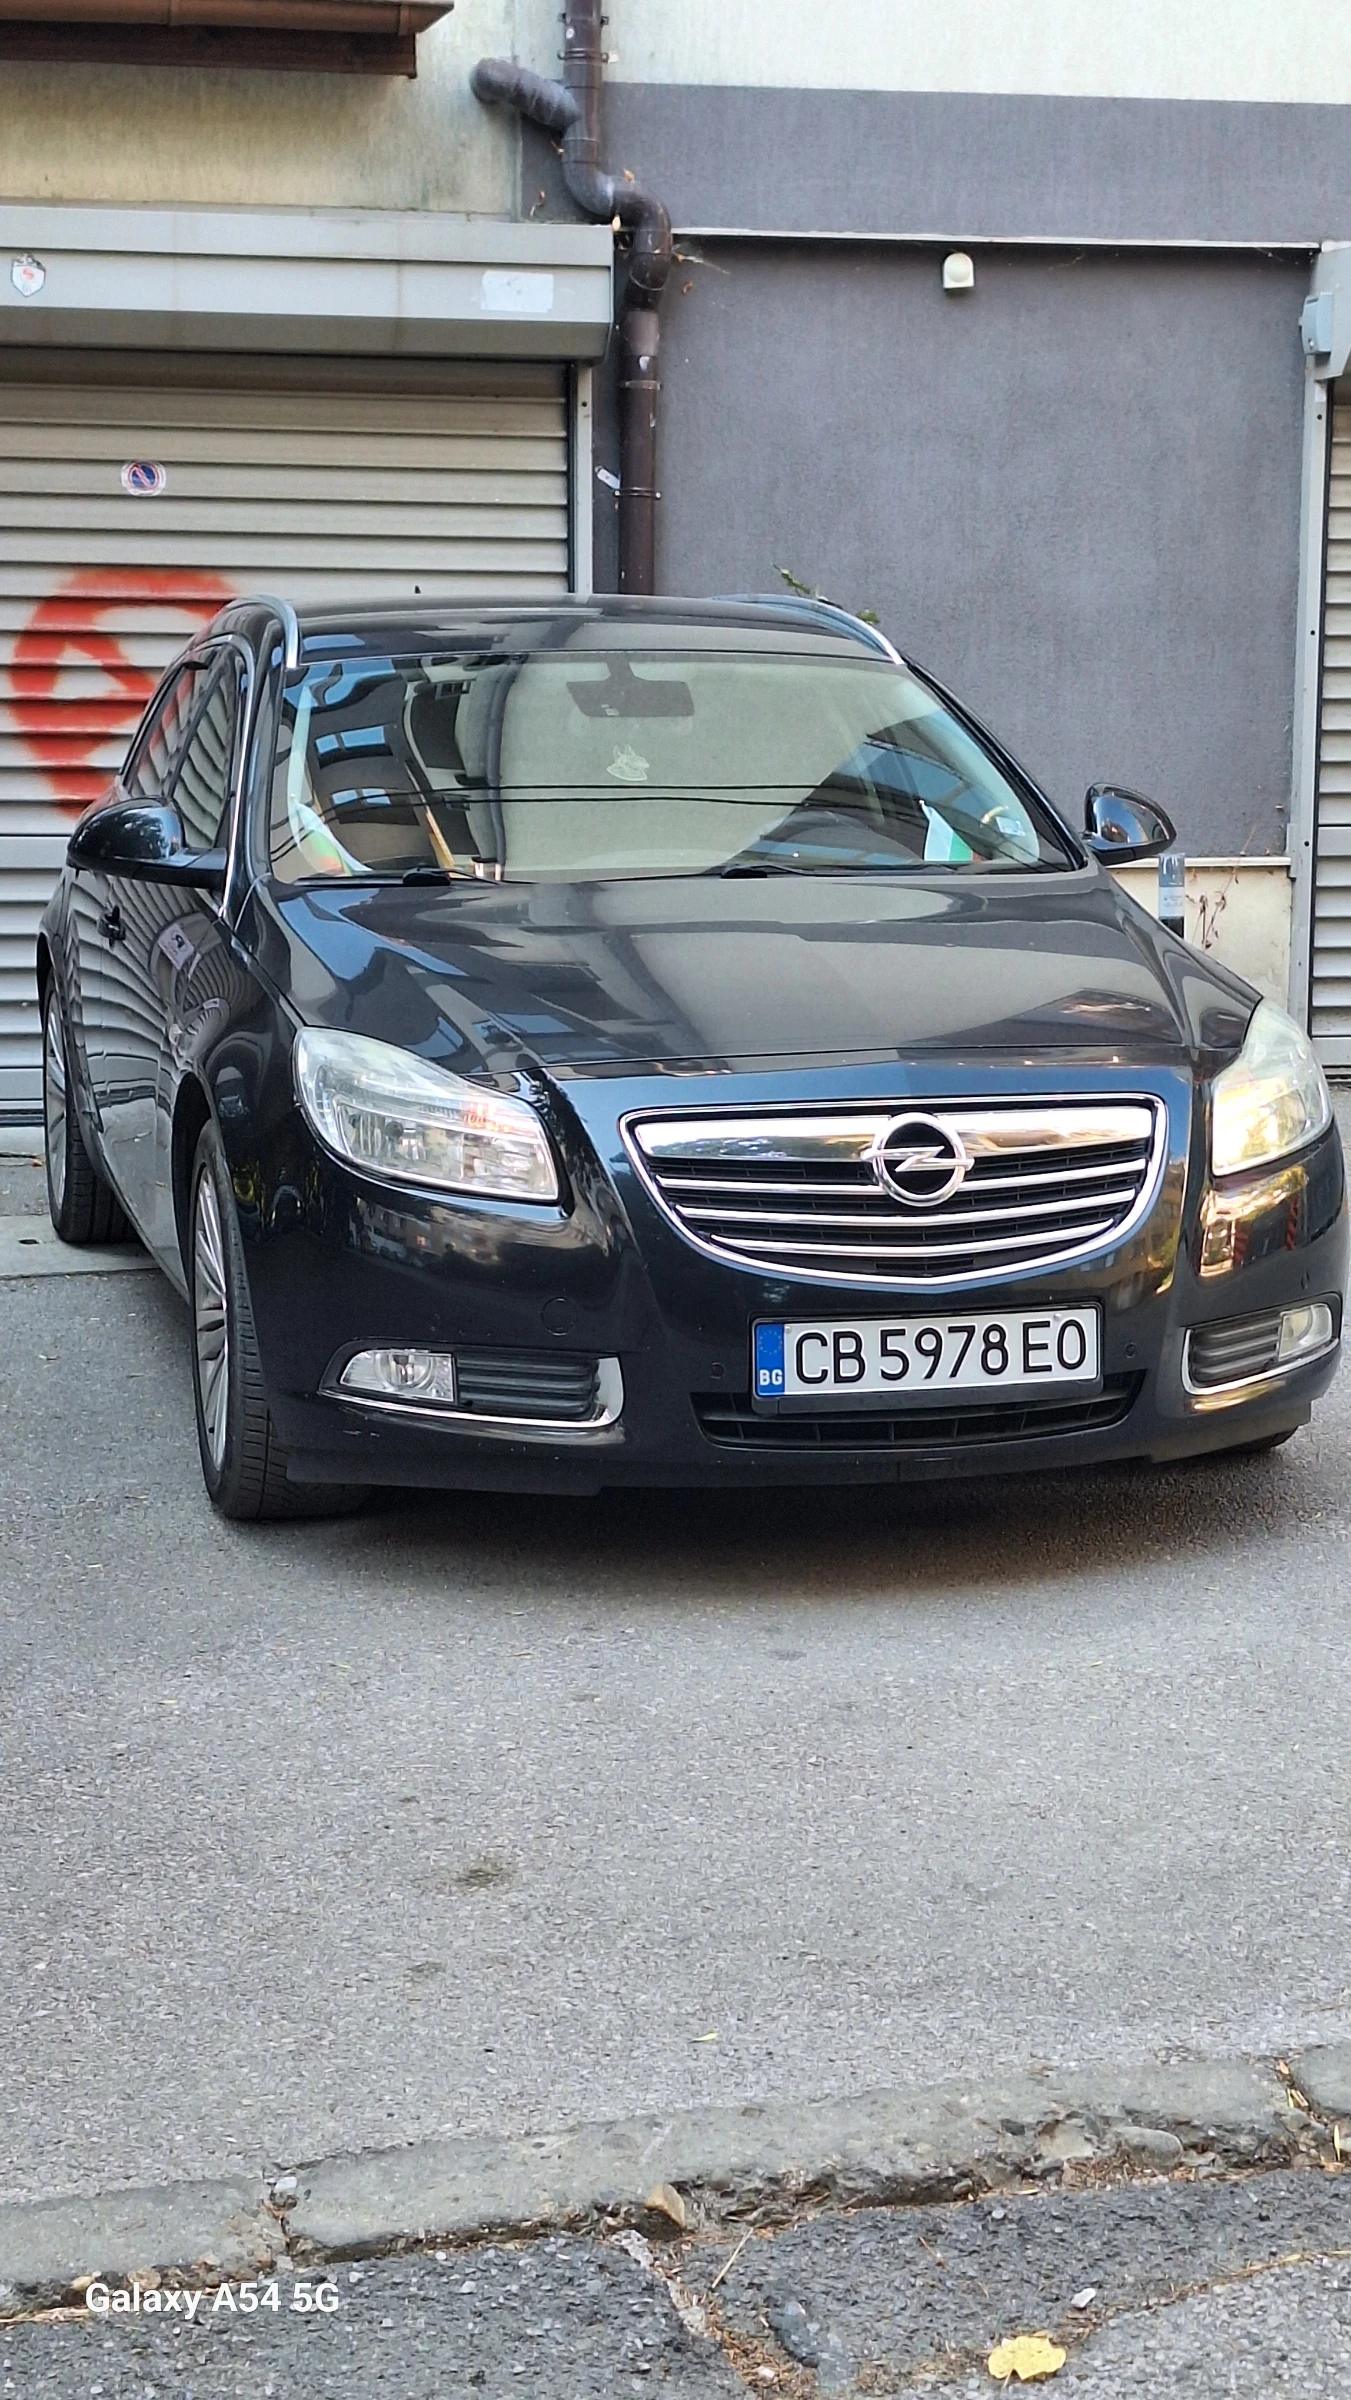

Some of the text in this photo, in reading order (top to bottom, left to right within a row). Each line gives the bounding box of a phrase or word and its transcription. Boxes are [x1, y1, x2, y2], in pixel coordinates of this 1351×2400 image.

[795, 1330, 866, 1385] CB
[880, 1323, 1009, 1381] 5978
[759, 1369, 783, 1386] BG
